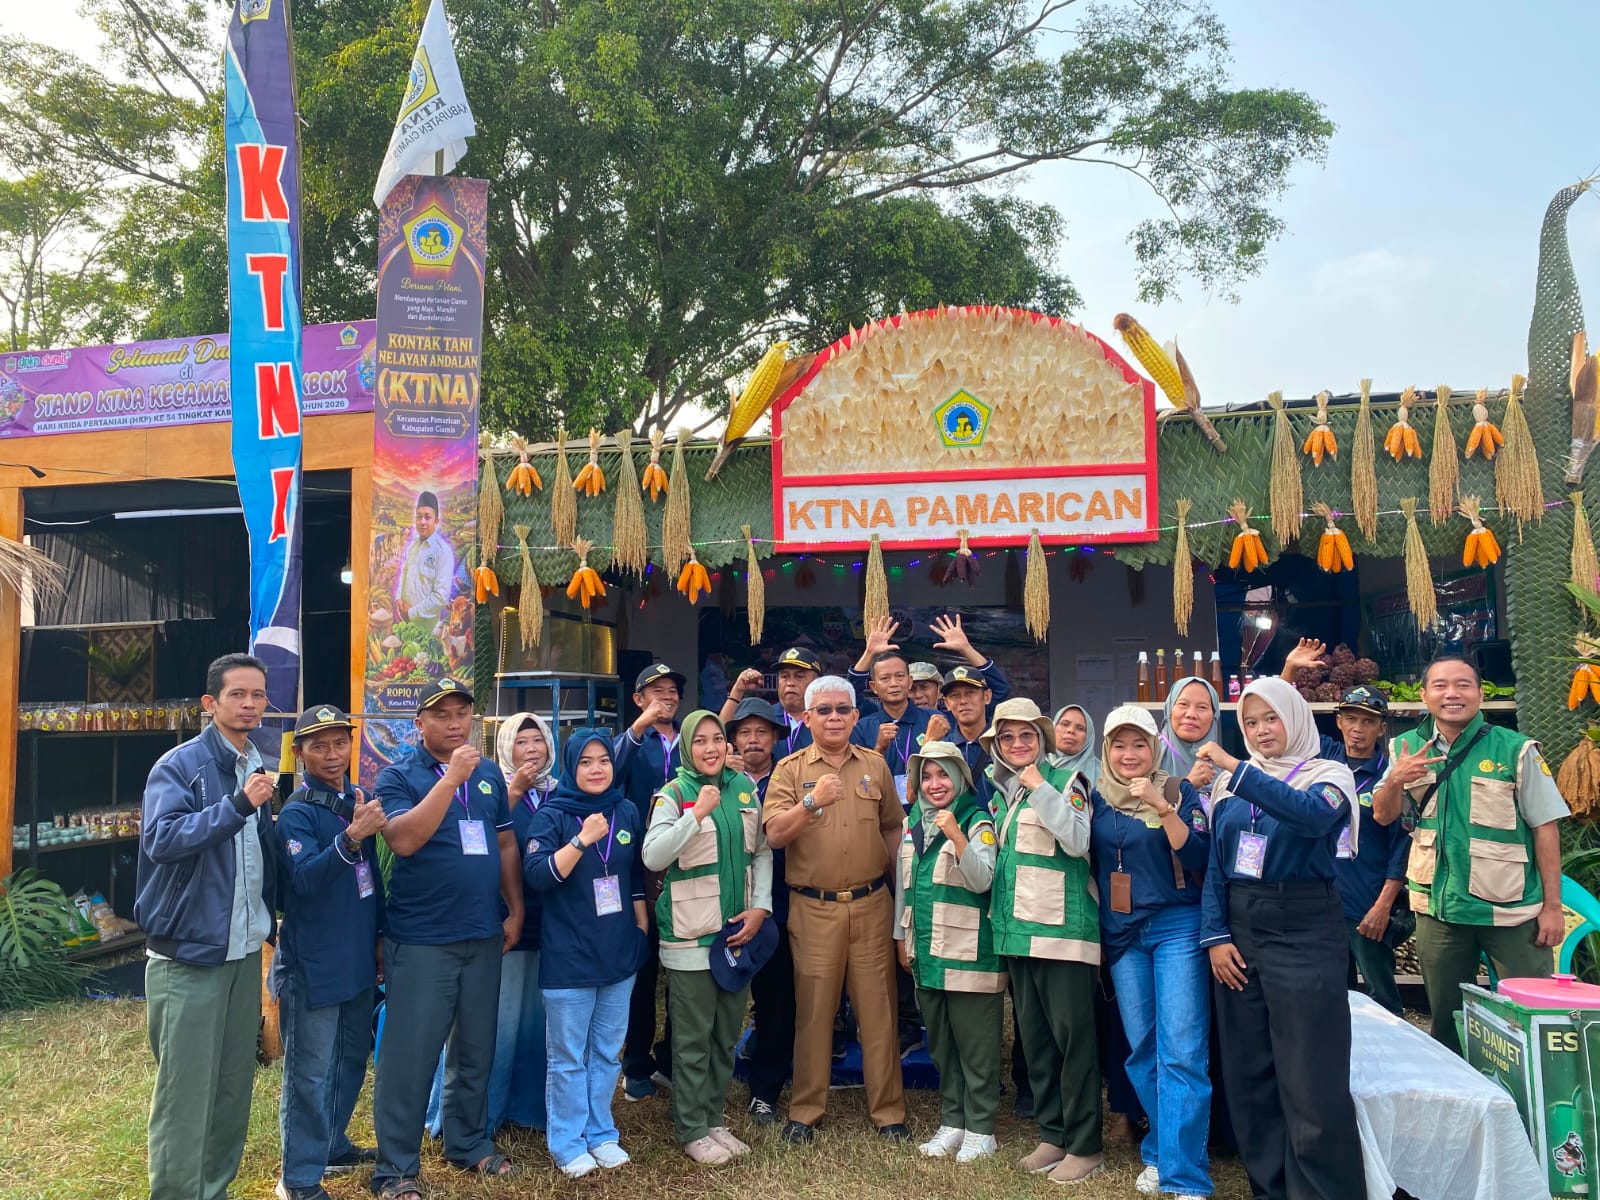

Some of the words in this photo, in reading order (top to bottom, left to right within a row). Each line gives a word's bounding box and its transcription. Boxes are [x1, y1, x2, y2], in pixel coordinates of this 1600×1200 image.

[388, 333, 441, 351] KONTAK
[443, 336, 473, 353] TANI
[106, 344, 189, 374] Selamat
[379, 350, 427, 367] NELAYAN
[429, 354, 478, 369] ANDALAN
[180, 364, 193, 380] di
[34, 391, 93, 418] STAND
[96, 387, 146, 413] KTNA
[149, 380, 231, 408] KECAMA
[378, 368, 480, 413] (KTNA)
[37, 423, 56, 431] HARI
[58, 421, 82, 430] KRIDA
[84, 417, 128, 427] PERTANIAN
[154, 414, 164, 422] KE
[178, 410, 214, 420] TINGKAT
[325, 400, 345, 408] 2026
[396, 414, 429, 423] Kecamatan
[430, 416, 461, 425] Pamarican
[402, 424, 434, 434] Kabupaten
[435, 425, 456, 434] Ciamis
[788, 498, 896, 531] KTNA
[906, 488, 1142, 527] PAMARICAN
[1468, 1017, 1481, 1040] ES
[1483, 1024, 1521, 1066] DAWET
[1547, 1031, 1578, 1052] ES
